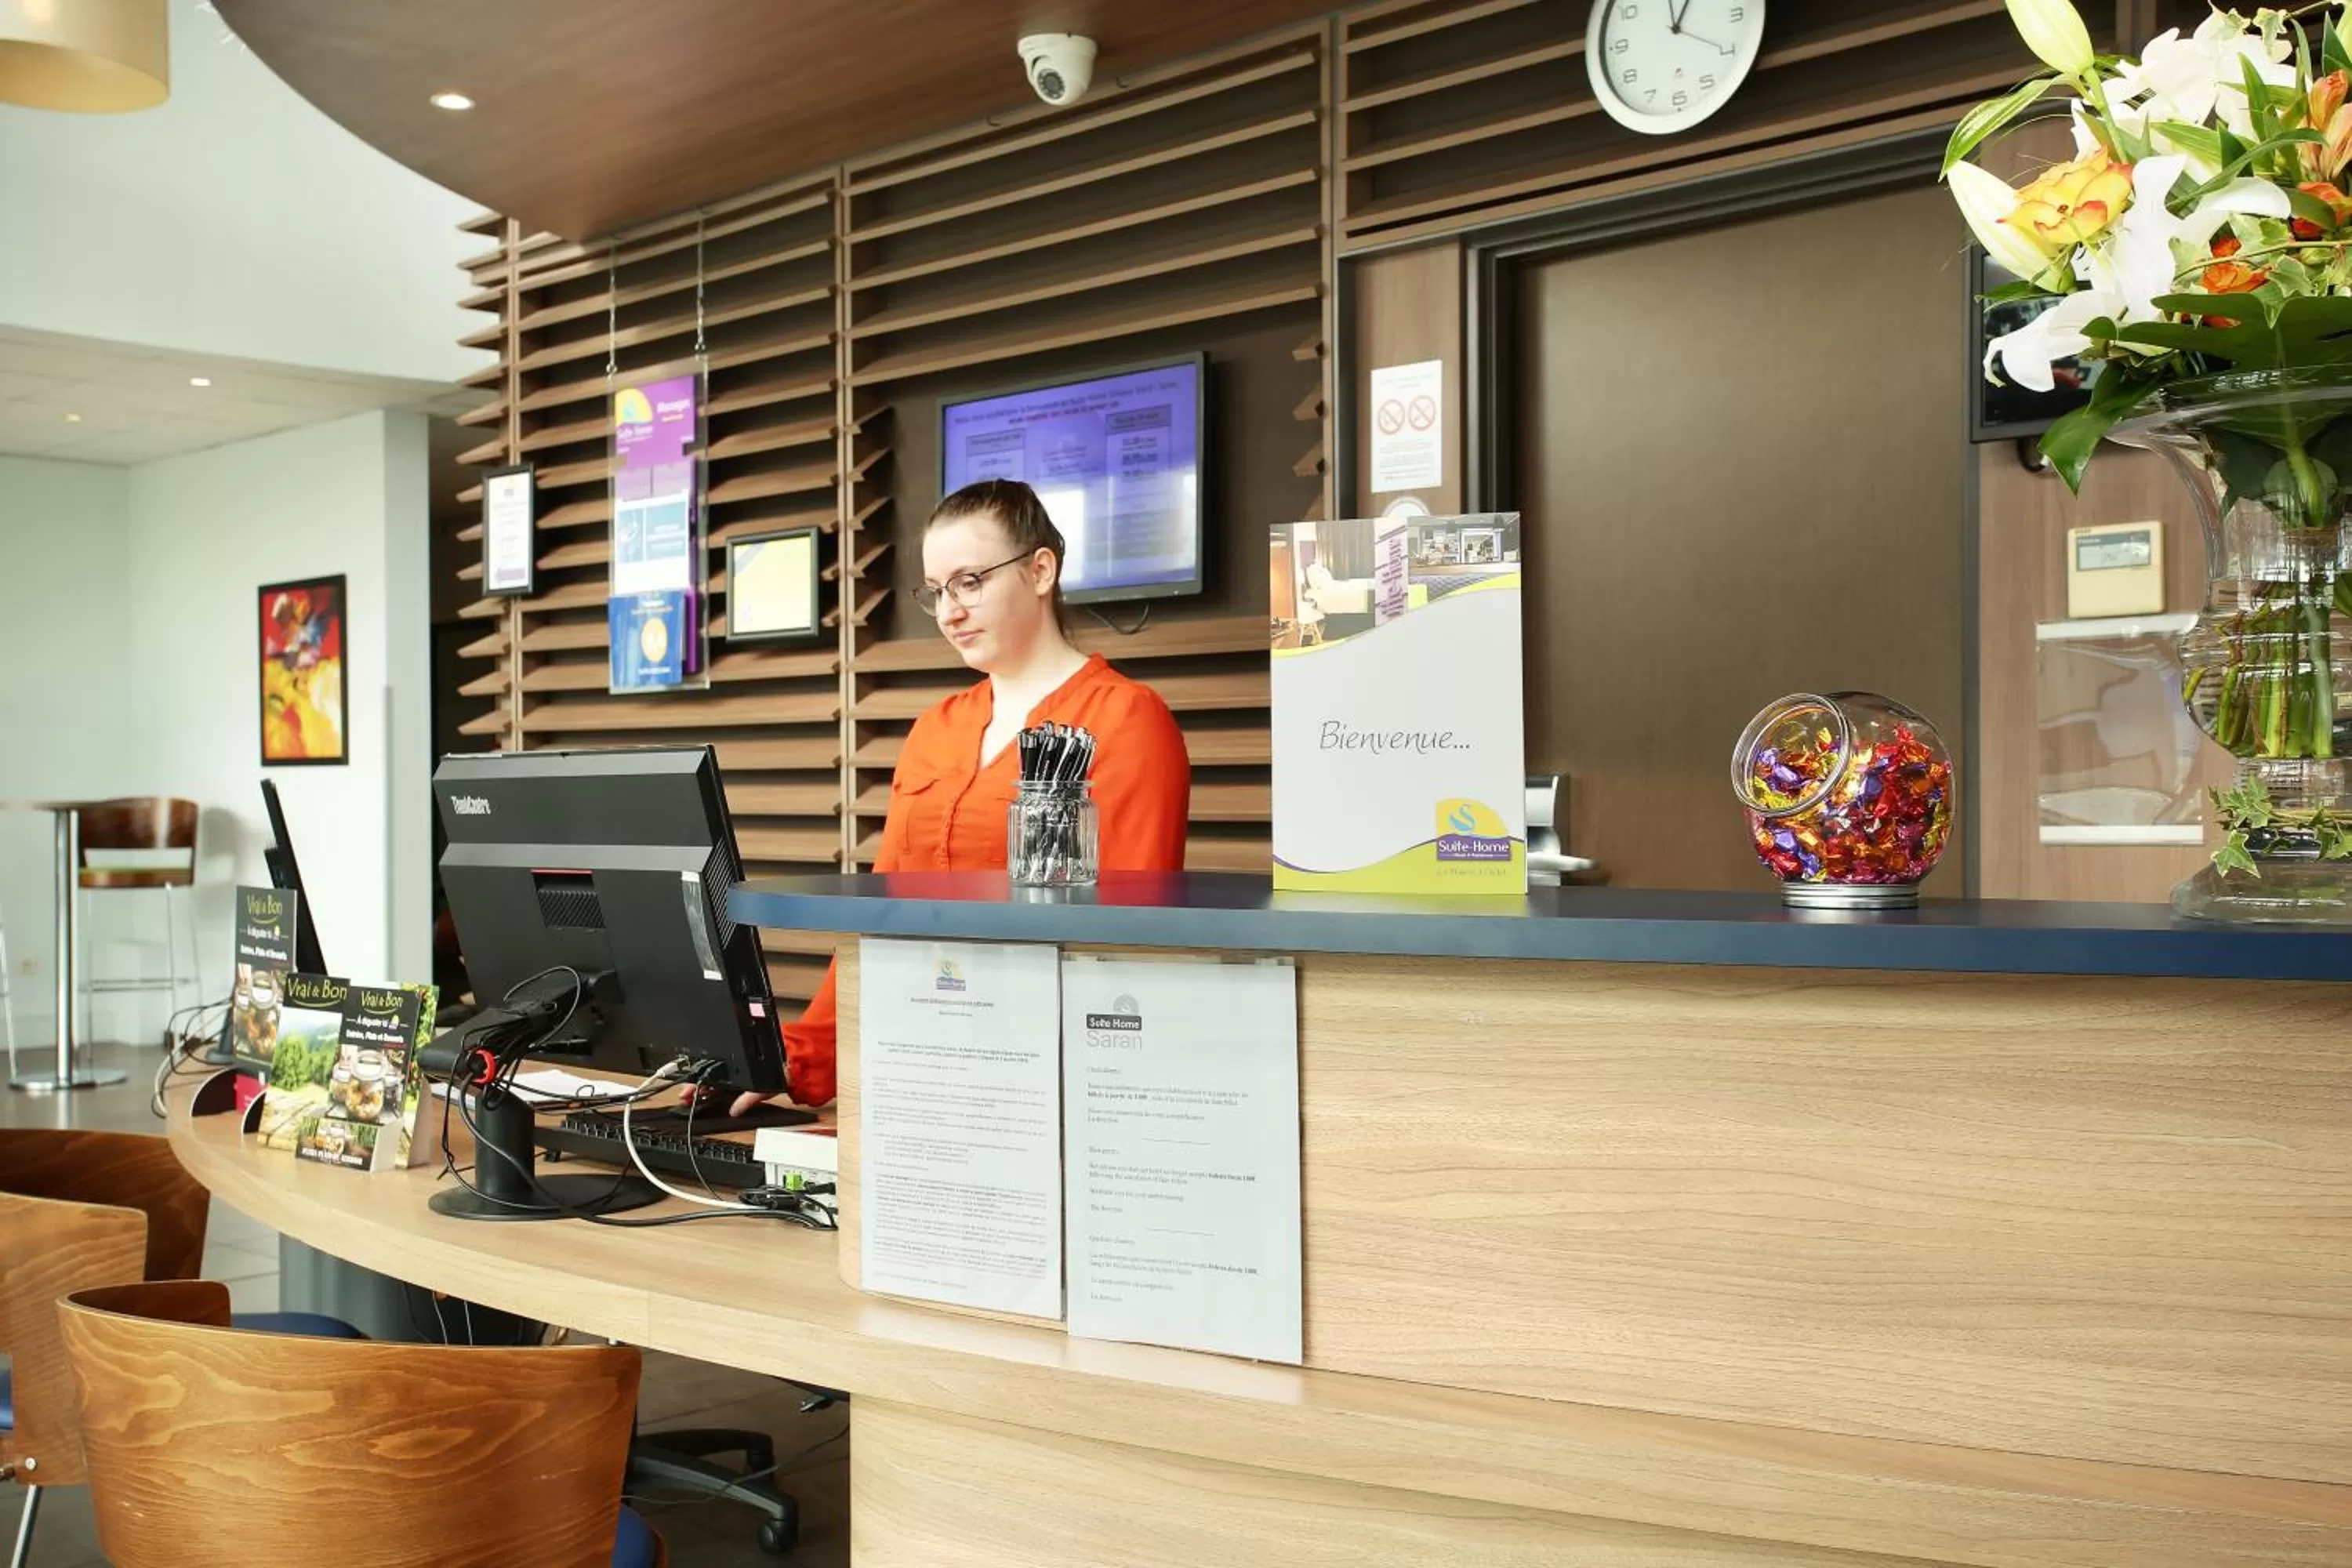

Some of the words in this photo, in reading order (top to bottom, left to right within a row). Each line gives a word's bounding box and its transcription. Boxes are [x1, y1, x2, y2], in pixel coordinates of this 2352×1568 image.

[1621, 5, 1638, 20] 10
[1730, 6, 1744, 24] 3
[1614, 38, 1628, 54] 9
[1719, 43, 1736, 58] 4
[1623, 68, 1638, 84] 8
[1699, 74, 1715, 90] 5
[1643, 89, 1657, 103] 7
[1672, 90, 1687, 106] 6
[1319, 720, 1470, 755] Bienvenue...
[1439, 840, 1509, 853] Suite-Home
[288, 978, 311, 1000] Vrai
[321, 979, 347, 1001] Bon
[361, 990, 378, 1007] Vrai
[385, 991, 404, 1008] Bon
[1086, 1030, 1142, 1051] Saran
